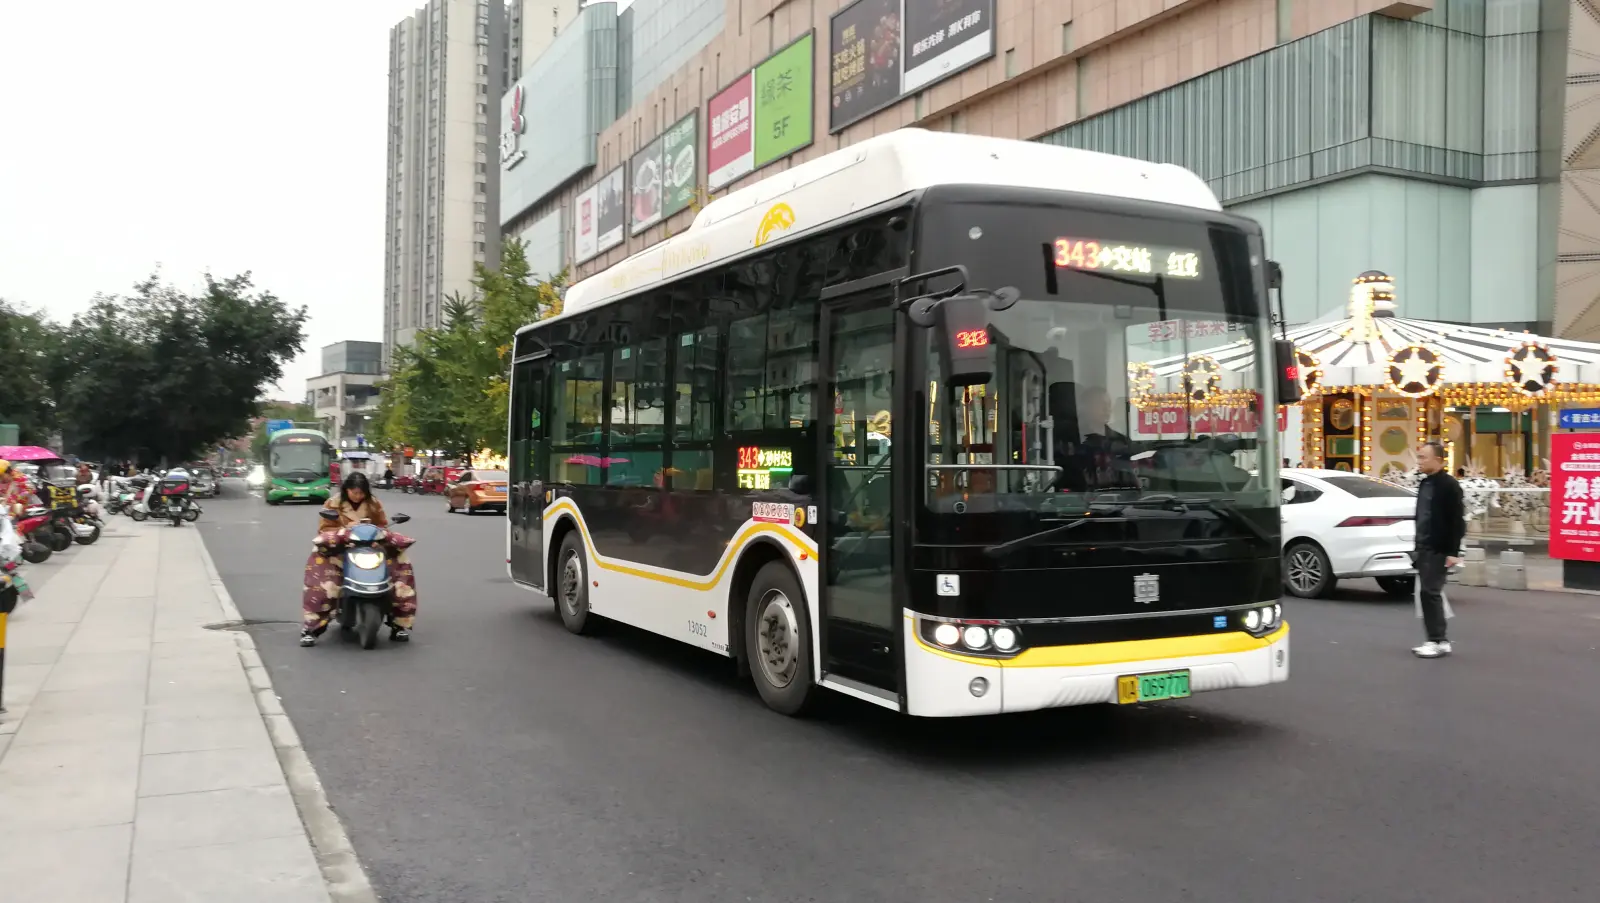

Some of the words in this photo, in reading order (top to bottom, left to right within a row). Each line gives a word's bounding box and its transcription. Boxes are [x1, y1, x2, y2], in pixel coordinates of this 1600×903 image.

[773, 115, 791, 139] 5F
[1055, 238, 1101, 269] 343
[957, 330, 988, 348] 343
[738, 446, 759, 469] 343
[687, 619, 708, 638] 13052
